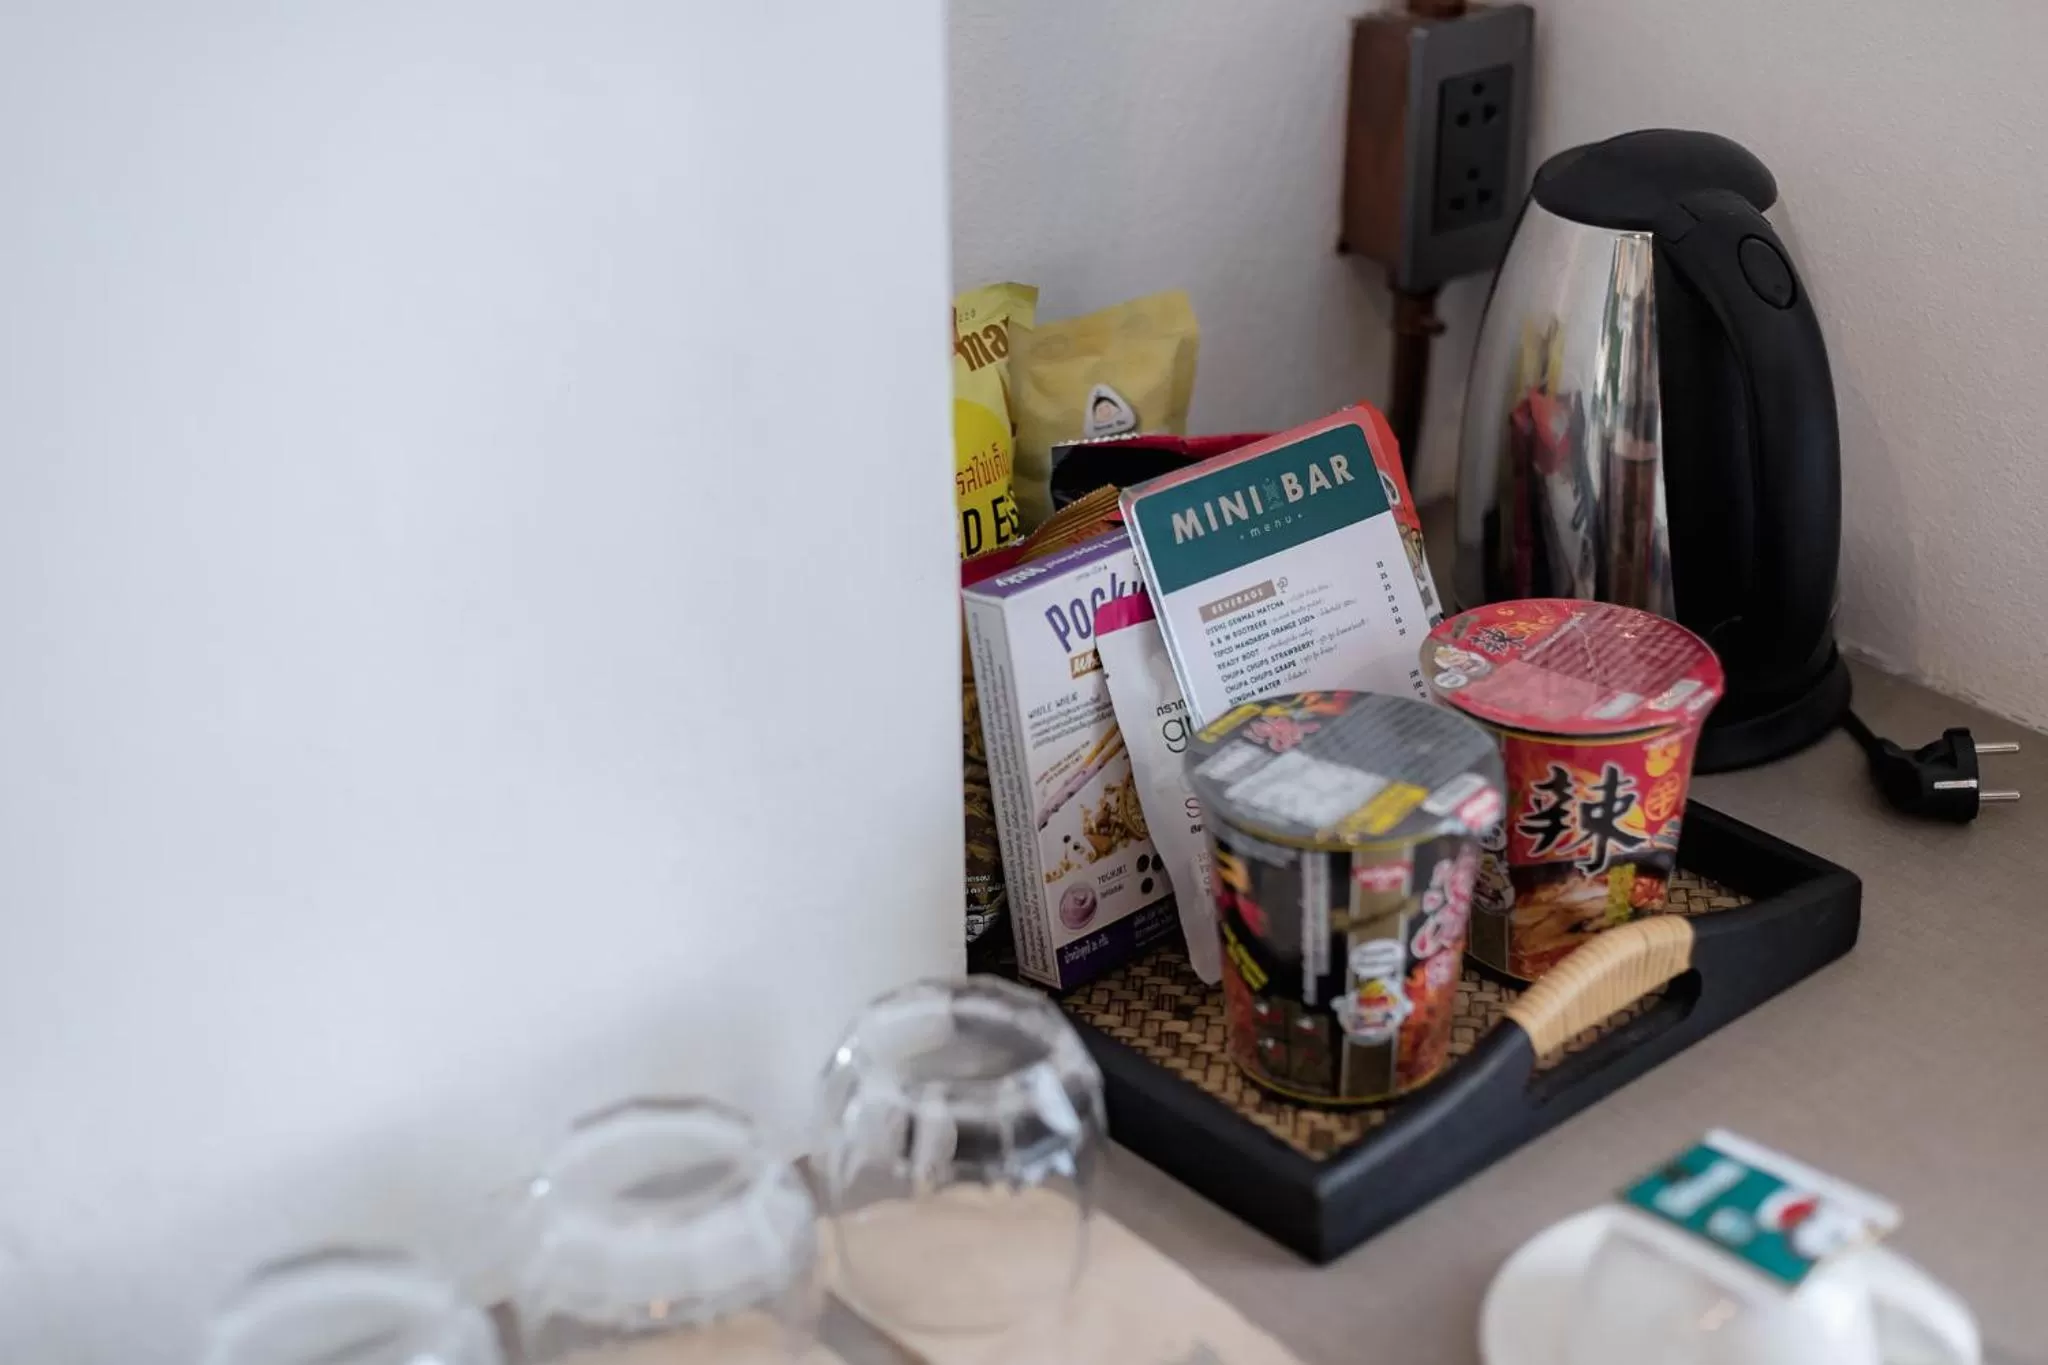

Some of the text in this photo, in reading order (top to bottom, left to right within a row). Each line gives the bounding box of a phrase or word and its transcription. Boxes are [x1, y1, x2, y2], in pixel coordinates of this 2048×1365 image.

[1171, 454, 1355, 545] MINI BAR
[960, 508, 982, 559] D
[1250, 515, 1292, 538] menu
[1211, 588, 1264, 615] BEVERAGE
[1257, 600, 1284, 615] MATCHA
[1235, 632, 1270, 650] MANDARIN
[1271, 620, 1297, 636] ORANGE
[1221, 669, 1244, 683] CHUPA
[1246, 658, 1269, 673] CHUPS
[1270, 640, 1314, 662] STRAWBERRY
[1225, 680, 1248, 694] CHUPA
[1250, 669, 1273, 684] CHUPS
[1274, 659, 1297, 674] GRAPE
[1257, 679, 1281, 693] WATER
[1516, 761, 1651, 876] 辣
